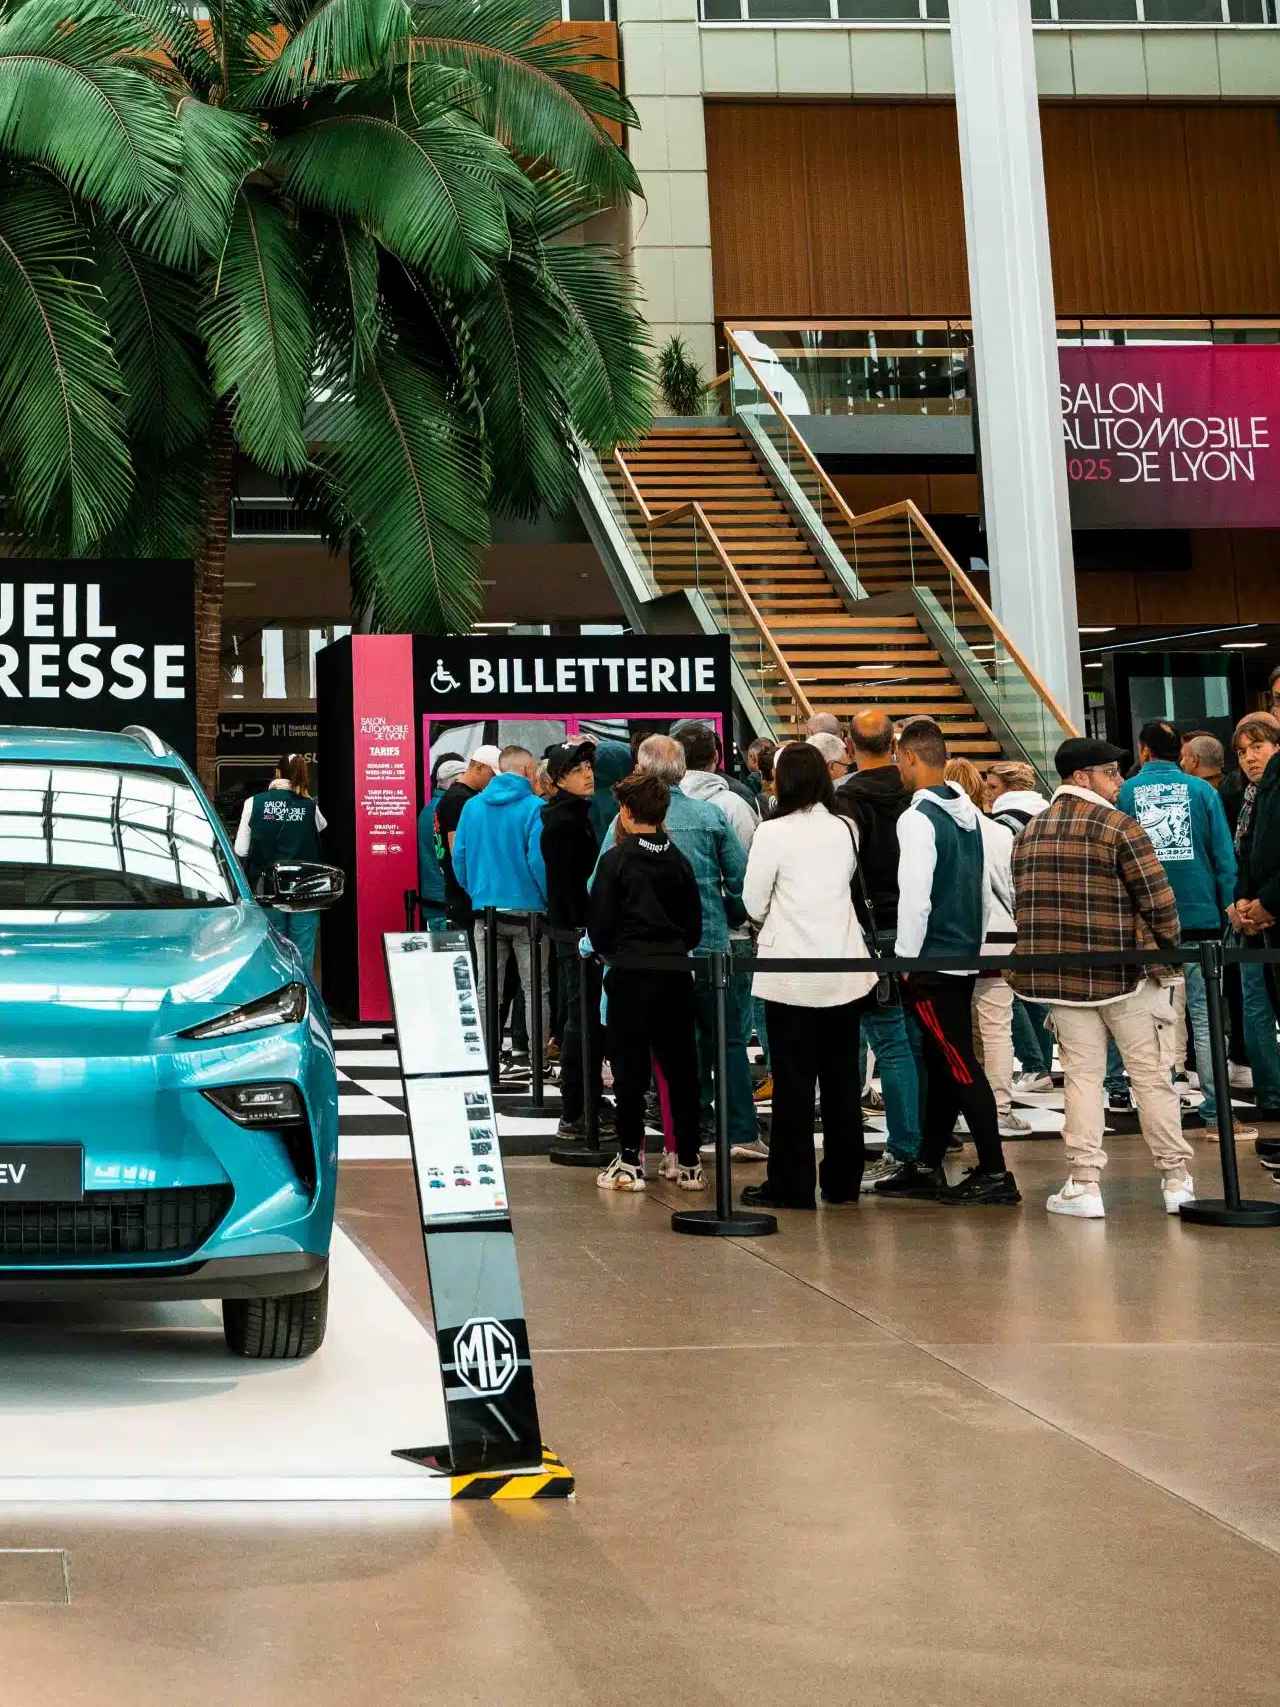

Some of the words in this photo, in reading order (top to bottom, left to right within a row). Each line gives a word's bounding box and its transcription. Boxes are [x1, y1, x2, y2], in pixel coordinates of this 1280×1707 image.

[1060, 382, 1164, 414] SALON
[1069, 458, 1113, 481] 025
[1117, 451, 1160, 483] DE
[1170, 450, 1255, 482] LYON
[469, 657, 716, 694] BILLETTERIE
[361, 717, 386, 725] SALON
[216, 723, 265, 738] YD
[288, 723, 312, 731] Mondial
[360, 724, 409, 733] AUTOMOBILE
[385, 732, 406, 741] LYON
[369, 746, 400, 756] TARIFS
[263, 800, 287, 808] SALON
[459, 1323, 513, 1388] MG
